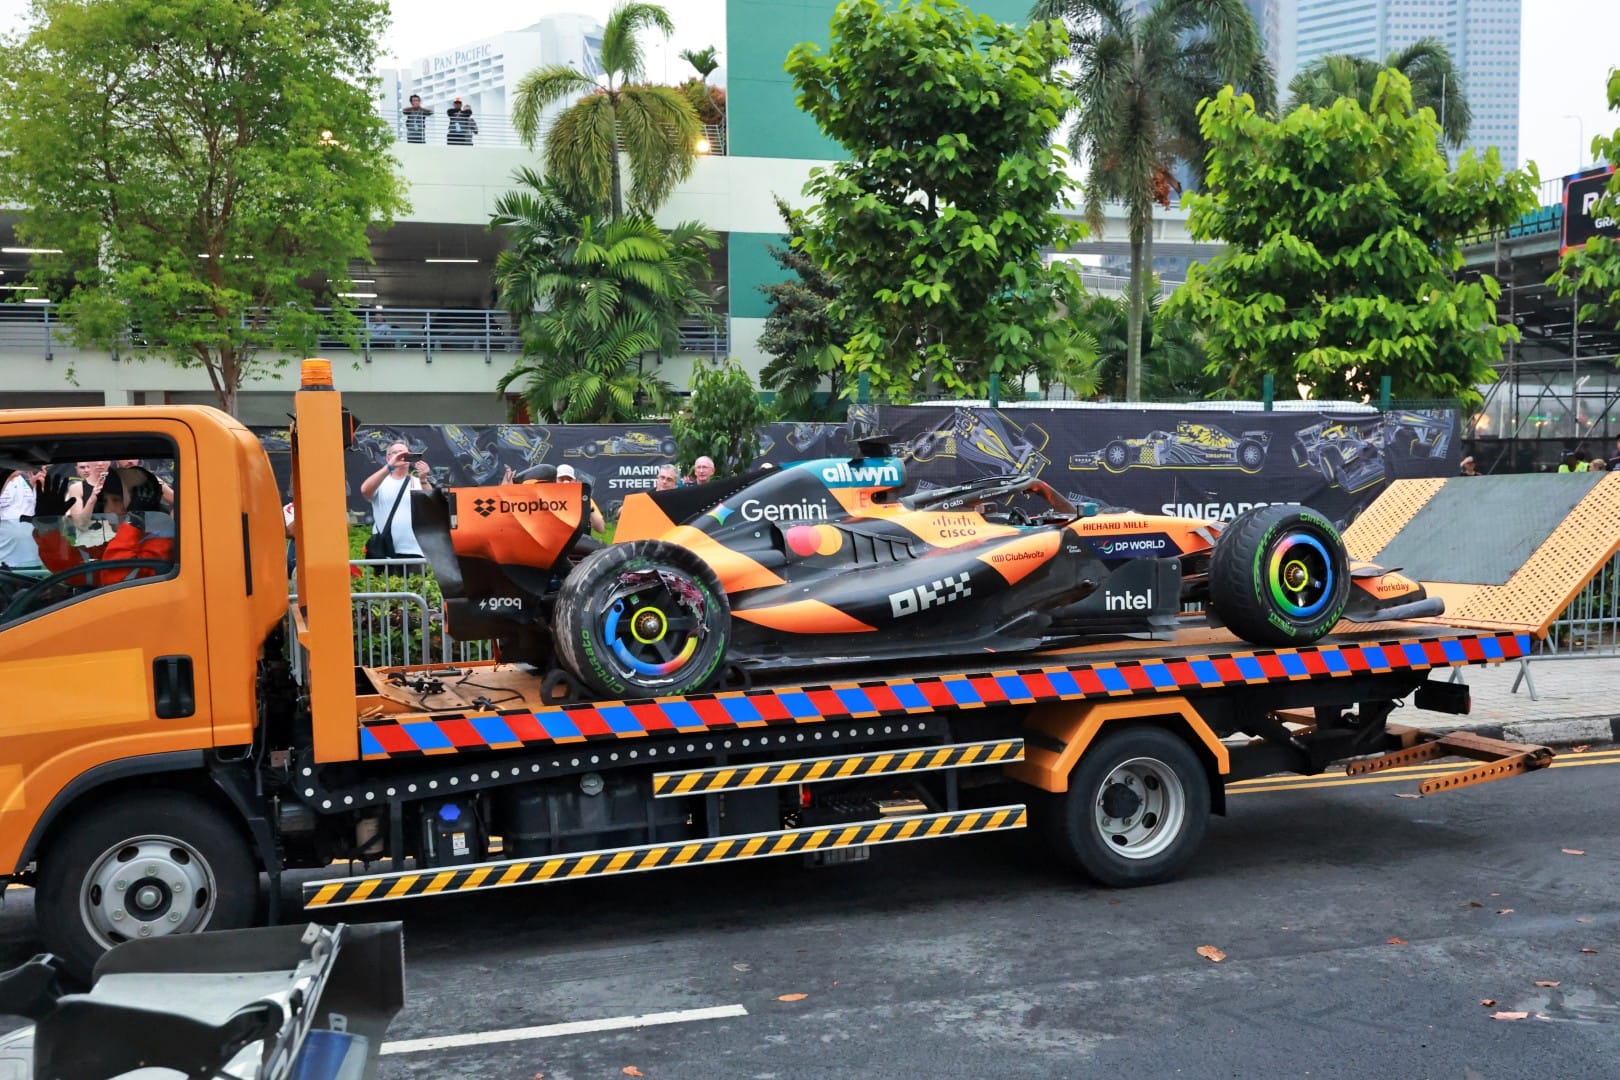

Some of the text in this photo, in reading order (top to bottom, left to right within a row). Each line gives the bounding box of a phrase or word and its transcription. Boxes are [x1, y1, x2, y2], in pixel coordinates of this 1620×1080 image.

[434, 44, 491, 71] PAN PACIFIC
[1594, 216, 1620, 229] GRA
[619, 465, 661, 476] MARIN
[822, 462, 899, 486] allwyn
[500, 498, 569, 515] Dropbox
[741, 498, 828, 522] Gemini
[1161, 502, 1301, 522] SINGAP
[939, 528, 977, 539] CISCO
[1083, 520, 1150, 532] RICHARD MILLE
[1115, 539, 1166, 552] DP WORLD
[1005, 550, 1045, 562] ClubAvolta
[888, 571, 972, 618] OKX
[1376, 582, 1410, 593] workday
[489, 596, 522, 611] groq
[1105, 588, 1152, 611] intel
